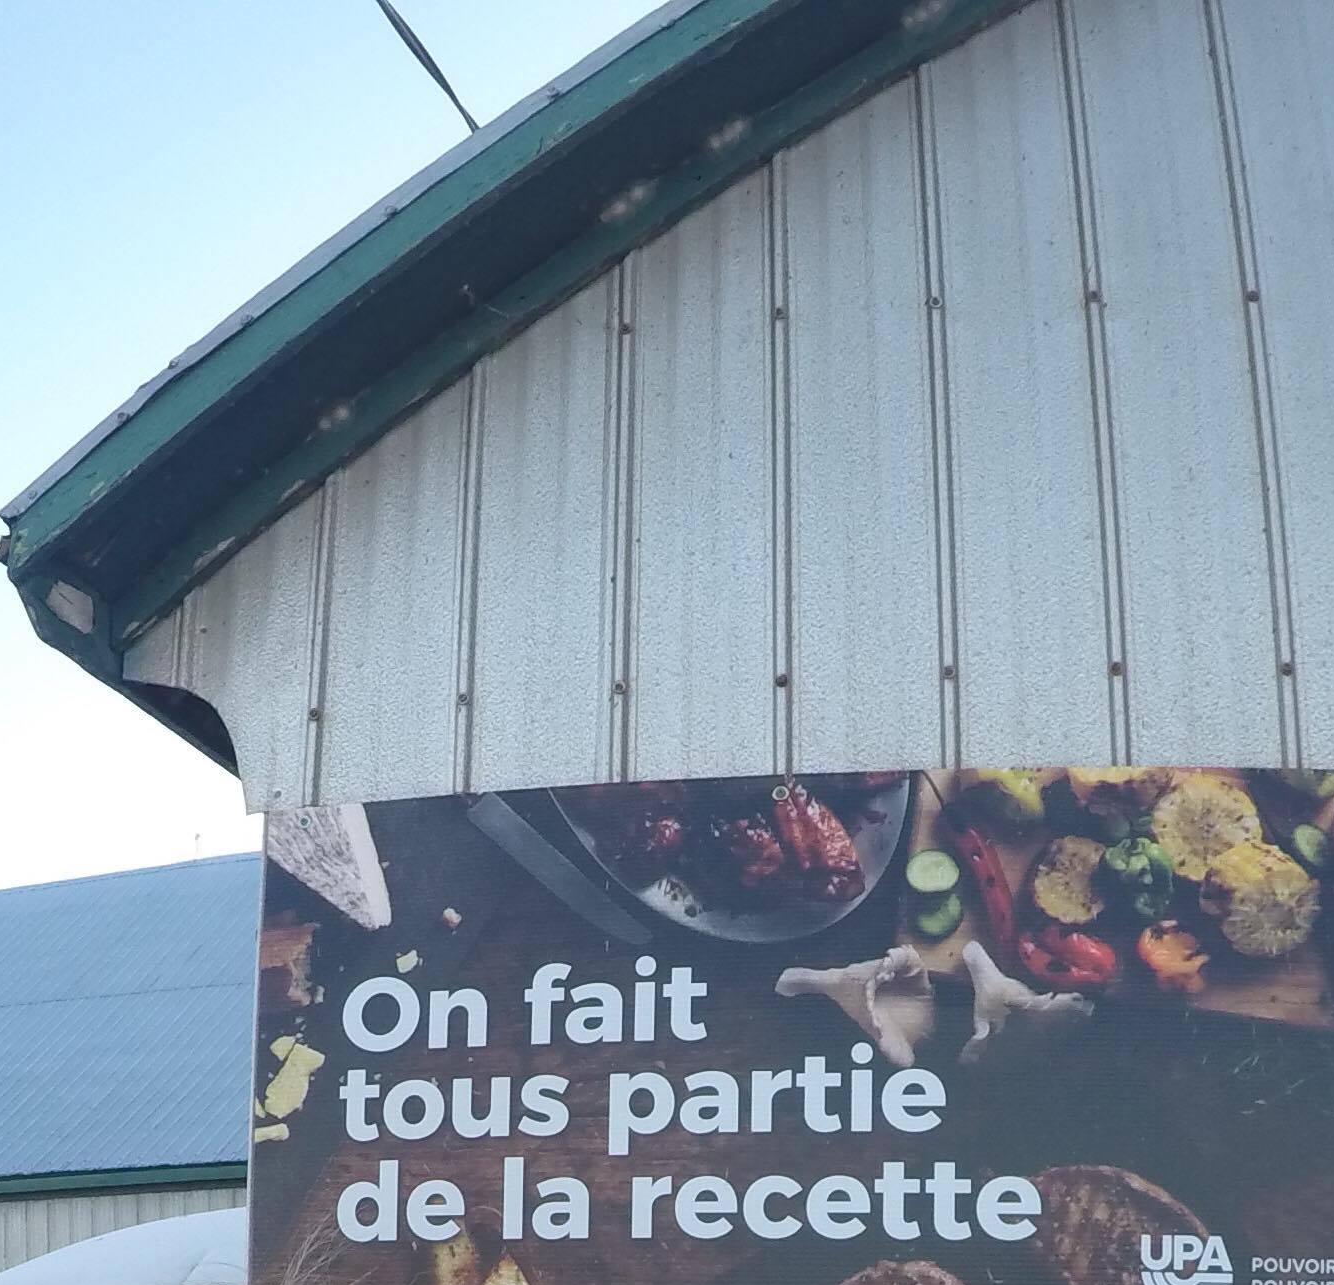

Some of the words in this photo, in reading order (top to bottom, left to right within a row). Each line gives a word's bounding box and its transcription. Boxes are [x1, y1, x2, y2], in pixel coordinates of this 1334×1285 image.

[340, 975, 489, 1053] On
[524, 954, 709, 1046] fait
[338, 1068, 571, 1142] tous
[607, 1042, 949, 1157] partie
[335, 1158, 466, 1244] de
[502, 1155, 591, 1241] la
[630, 1160, 1043, 1242] recette
[1139, 1233, 1234, 1272] UPA
